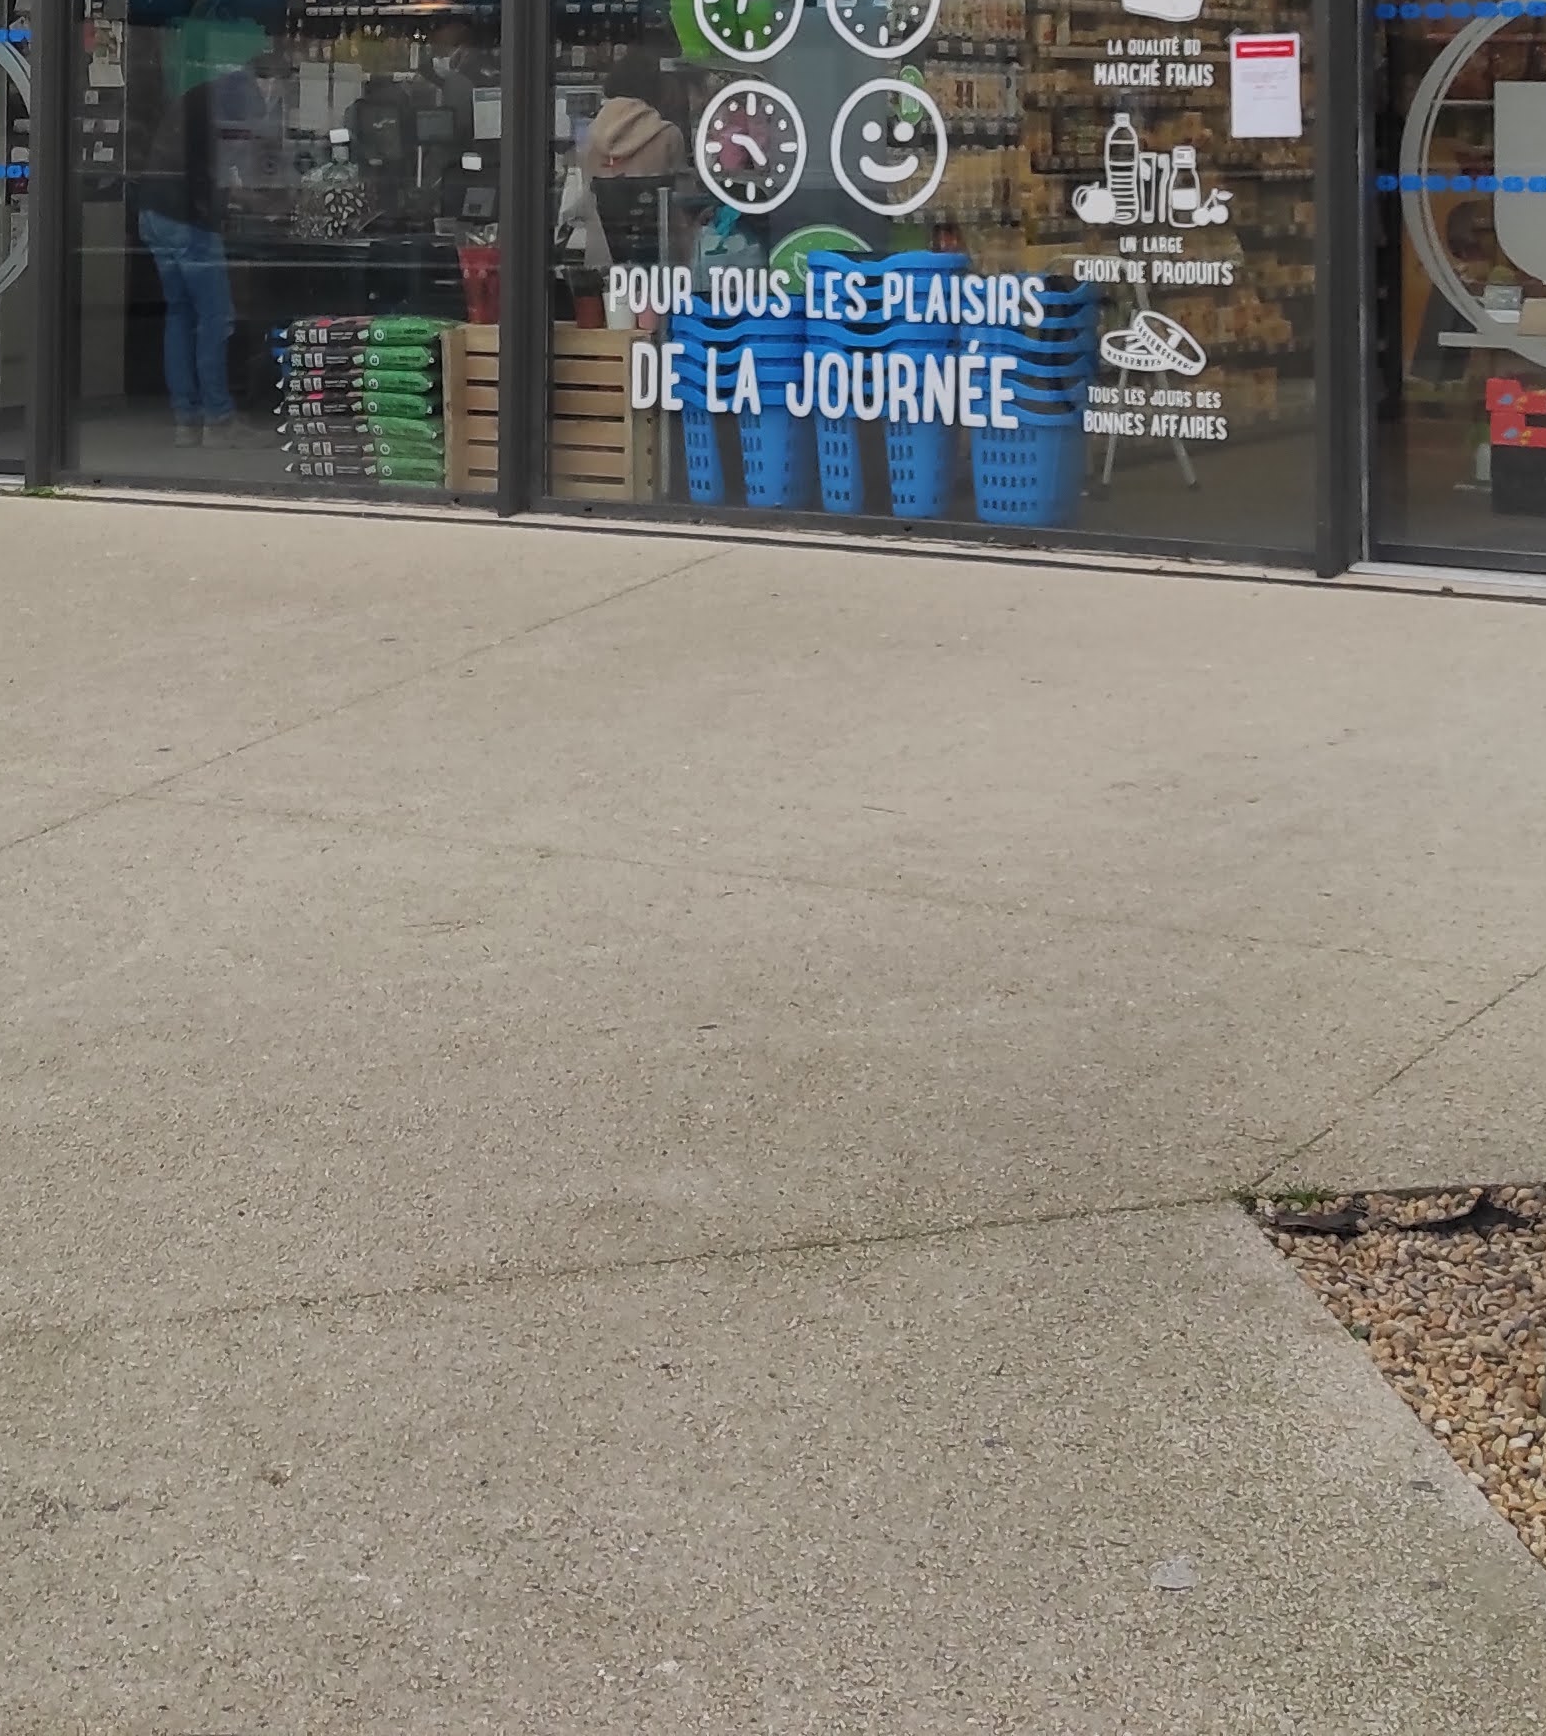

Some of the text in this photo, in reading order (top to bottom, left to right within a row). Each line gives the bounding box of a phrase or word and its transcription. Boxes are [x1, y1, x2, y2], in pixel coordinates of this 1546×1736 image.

[1107, 35, 1202, 57] LA QUALITÉ DU
[1093, 59, 1162, 87] MARCHÉ
[1165, 63, 1216, 87] FRAIS
[1119, 236, 1185, 254] UN LARGE
[1072, 259, 1235, 286] CHOIX DE PRODUITS
[608, 265, 1046, 328] POUR TOUS LES PLAISIRS
[631, 339, 1021, 431] DE LA JOURNÉE
[1086, 385, 1223, 410] TOUS LES JOURS DES
[1083, 409, 1230, 442] BONNES AFFAIRES
